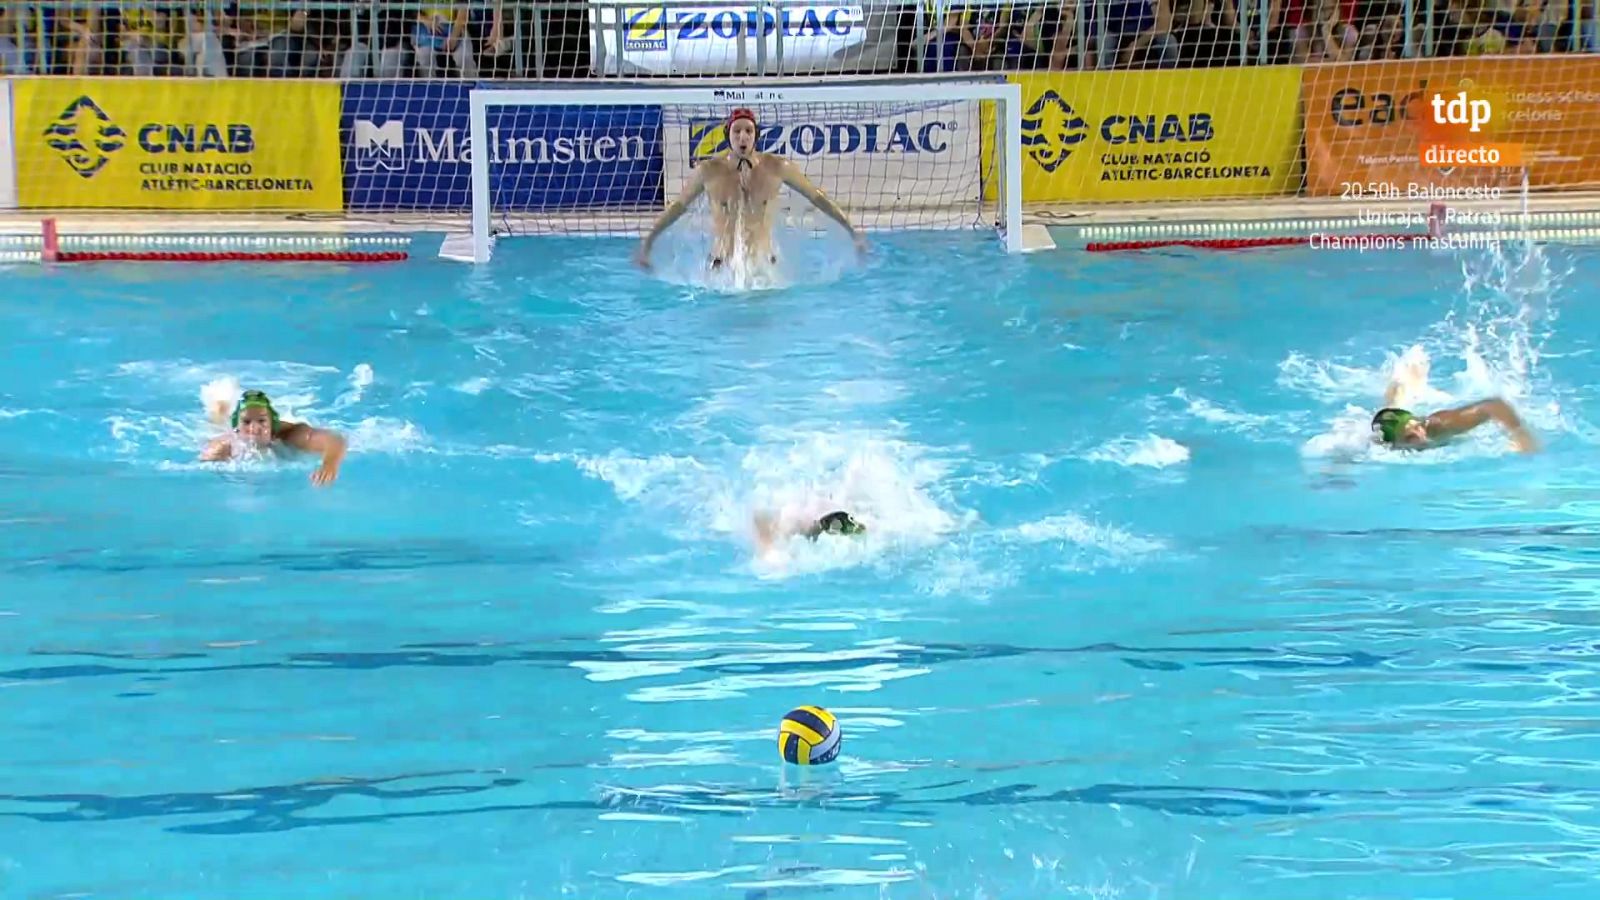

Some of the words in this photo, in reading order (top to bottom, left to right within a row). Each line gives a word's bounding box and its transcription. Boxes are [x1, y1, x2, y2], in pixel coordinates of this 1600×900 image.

[676, 8, 851, 40] ZODIAC
[138, 123, 255, 154] CNAB
[1100, 112, 1215, 144] CNAB
[414, 126, 646, 164] Malmsten
[1101, 153, 1139, 165] CLUB
[140, 163, 178, 175] CLUB
[184, 160, 252, 174] NATACIÓ
